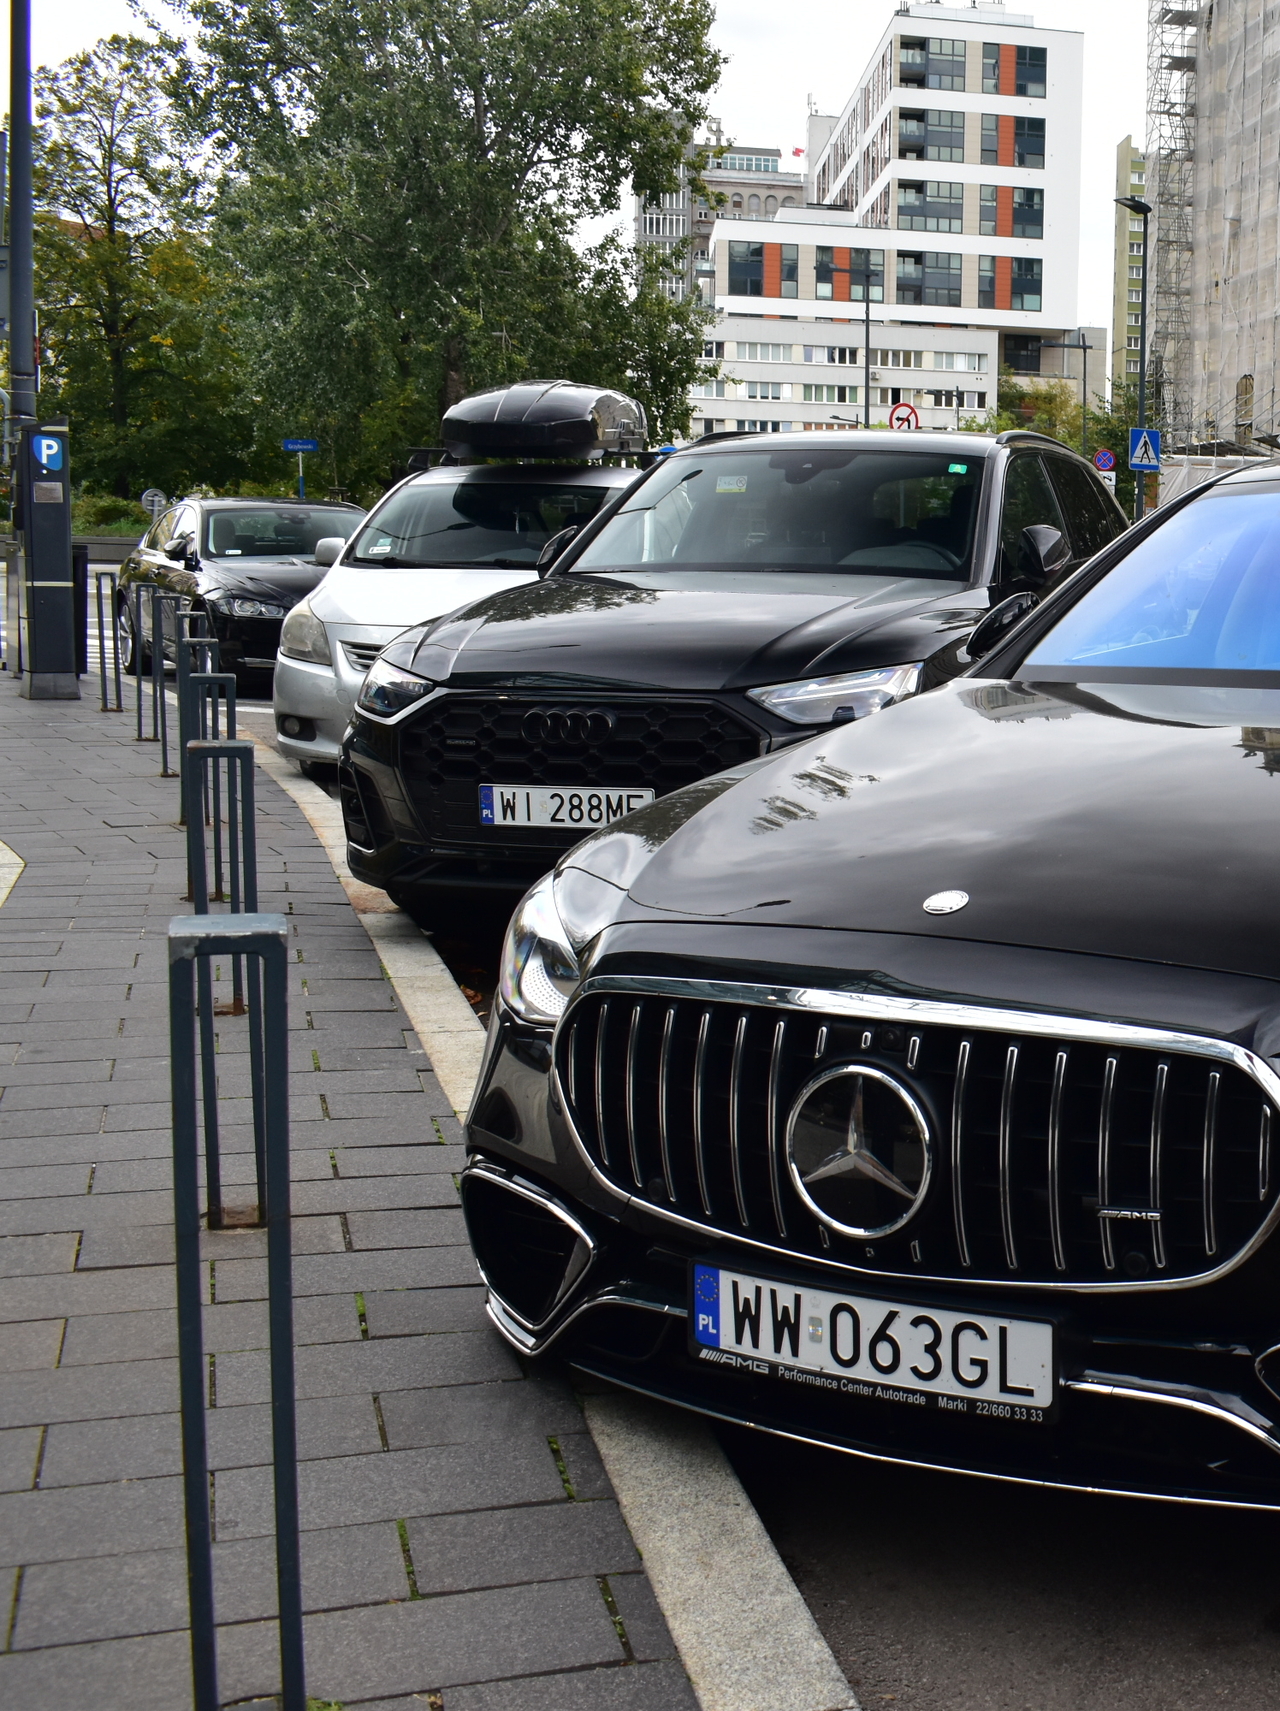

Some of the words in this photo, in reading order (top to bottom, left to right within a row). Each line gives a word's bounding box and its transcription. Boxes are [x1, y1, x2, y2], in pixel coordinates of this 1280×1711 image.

[41, 439, 58, 464] P
[482, 810, 493, 818] PL
[500, 791, 531, 822] WI
[1117, 1210, 1161, 1221] AMG
[698, 1314, 717, 1334] PL
[732, 1280, 802, 1358] WW
[829, 1302, 1034, 1397] 063GL
[721, 1354, 769, 1374] AMG
[778, 1366, 838, 1390] Performance
[840, 1380, 873, 1396] Center
[875, 1386, 926, 1405] Autotrade
[938, 1396, 967, 1412] Marki
[976, 1402, 1011, 1418] 22/660
[1014, 1407, 1027, 1420] 33
[1030, 1410, 1043, 1422] 33
